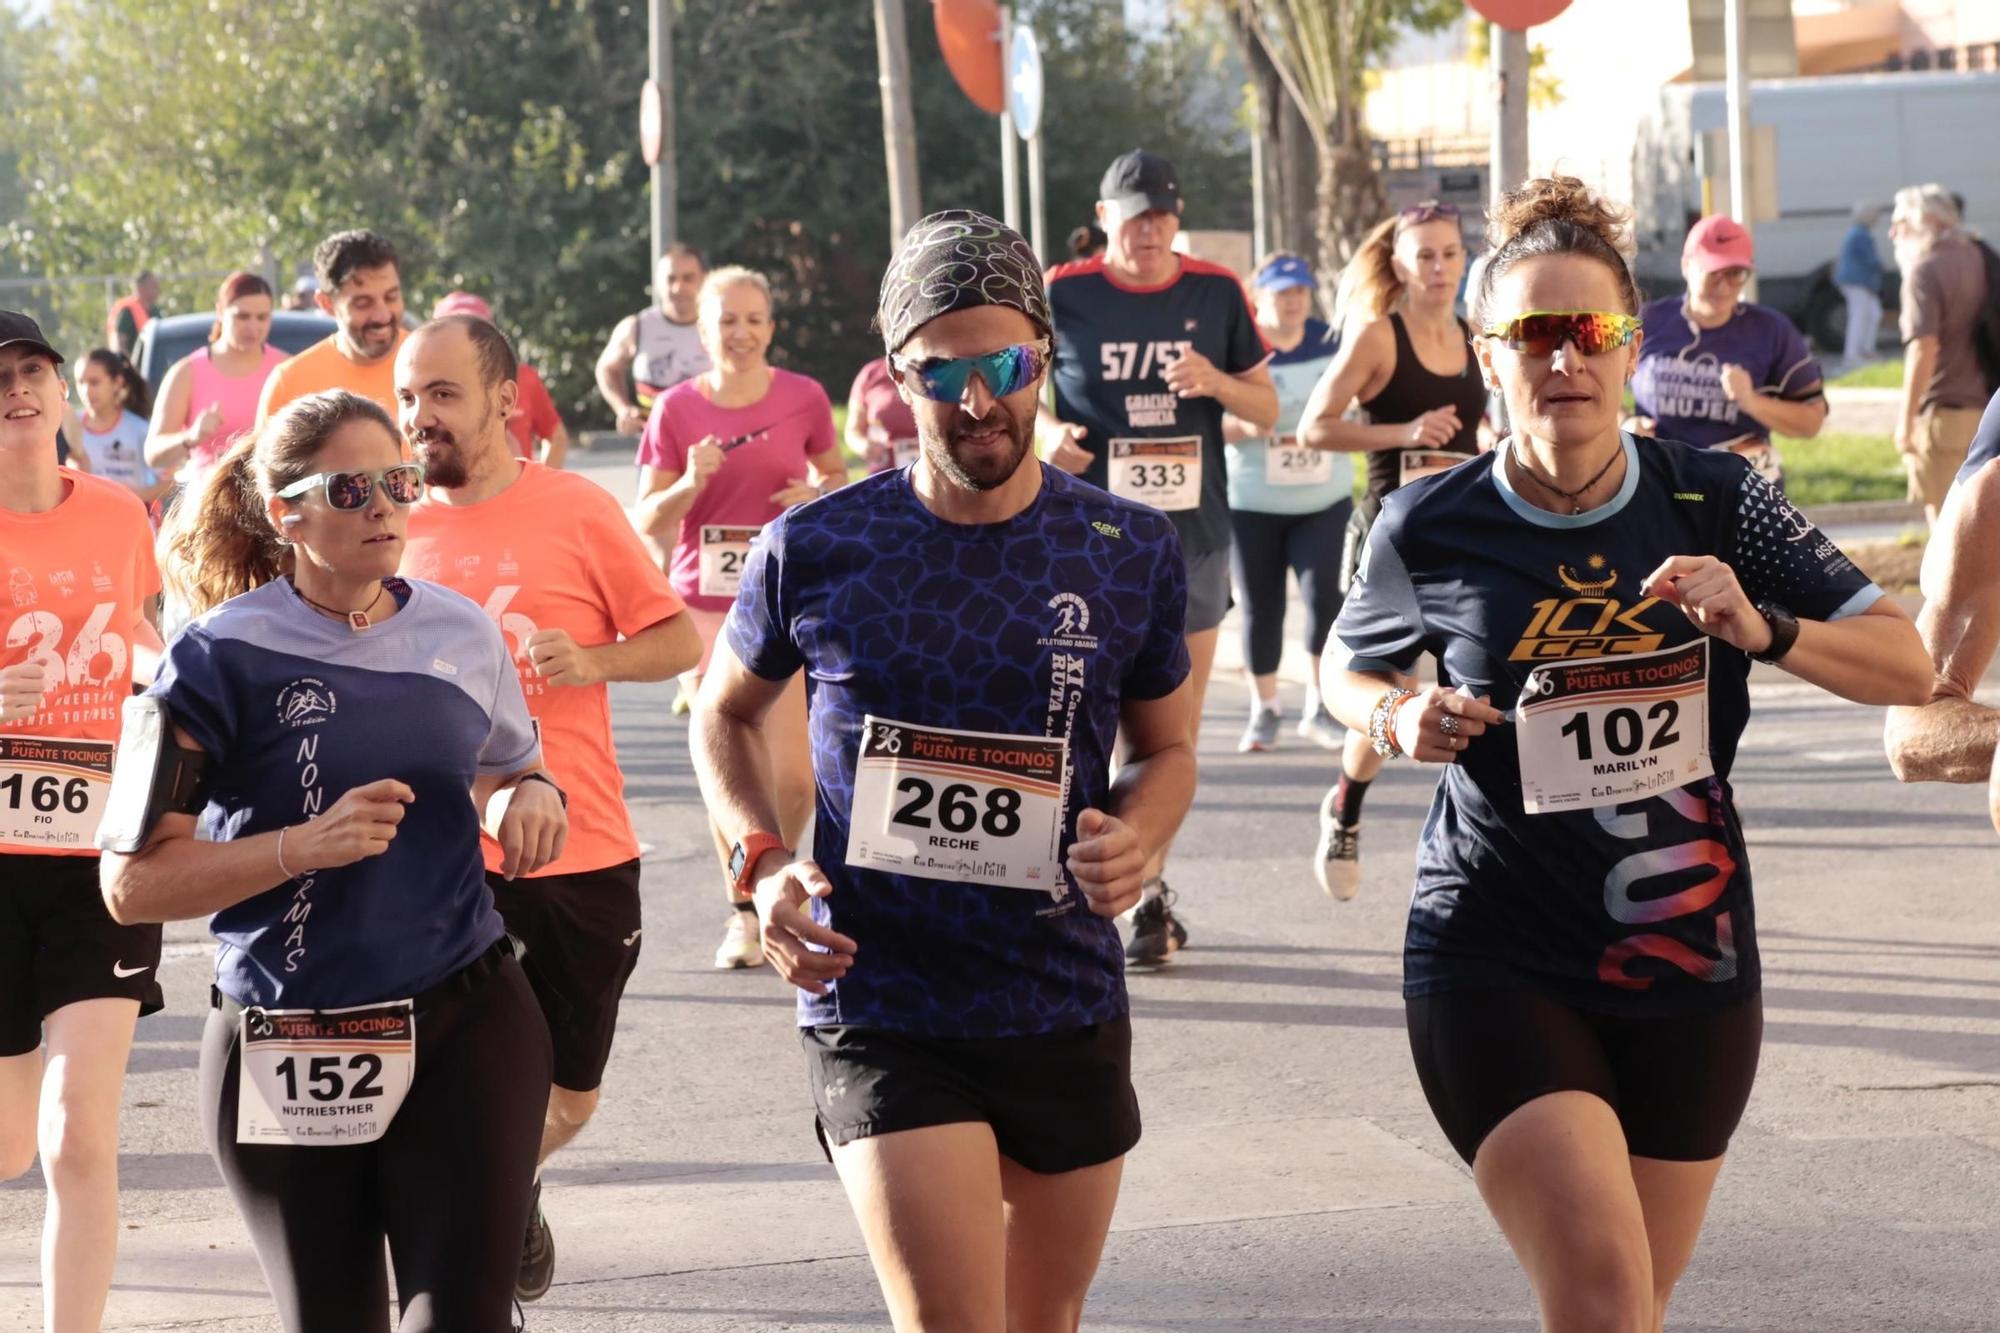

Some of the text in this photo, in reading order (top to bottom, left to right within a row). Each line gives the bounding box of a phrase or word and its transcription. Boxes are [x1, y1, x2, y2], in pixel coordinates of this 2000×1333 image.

[1125, 394, 1177, 411] GRACIAS
[1658, 398, 1738, 425] MUJER
[1130, 464, 1185, 487] 333
[1522, 596, 1662, 638] 10K
[6, 602, 127, 693] 36
[1036, 638, 1073, 647] ATLETISMO
[1531, 637, 1641, 658] CPC
[1049, 653, 1067, 712] RUTA
[1066, 653, 1084, 688] XI
[1566, 670, 1631, 690] PUENTE
[1635, 656, 1700, 681] TOCINOS
[875, 726, 902, 753] 36
[1561, 700, 1680, 760] 102
[11, 746, 108, 762] PUENTE TOCINOS
[912, 741, 1055, 768] PUENTE TOCINOS
[1593, 756, 1658, 775] MARILYN
[1, 773, 89, 814] 166
[892, 777, 1021, 837] 268
[34, 815, 52, 824] FIO
[929, 835, 979, 851] RECHE
[339, 1017, 405, 1034] TOCINOS
[276, 1053, 383, 1101] 152
[282, 1103, 373, 1117] NUTRIESTHER
